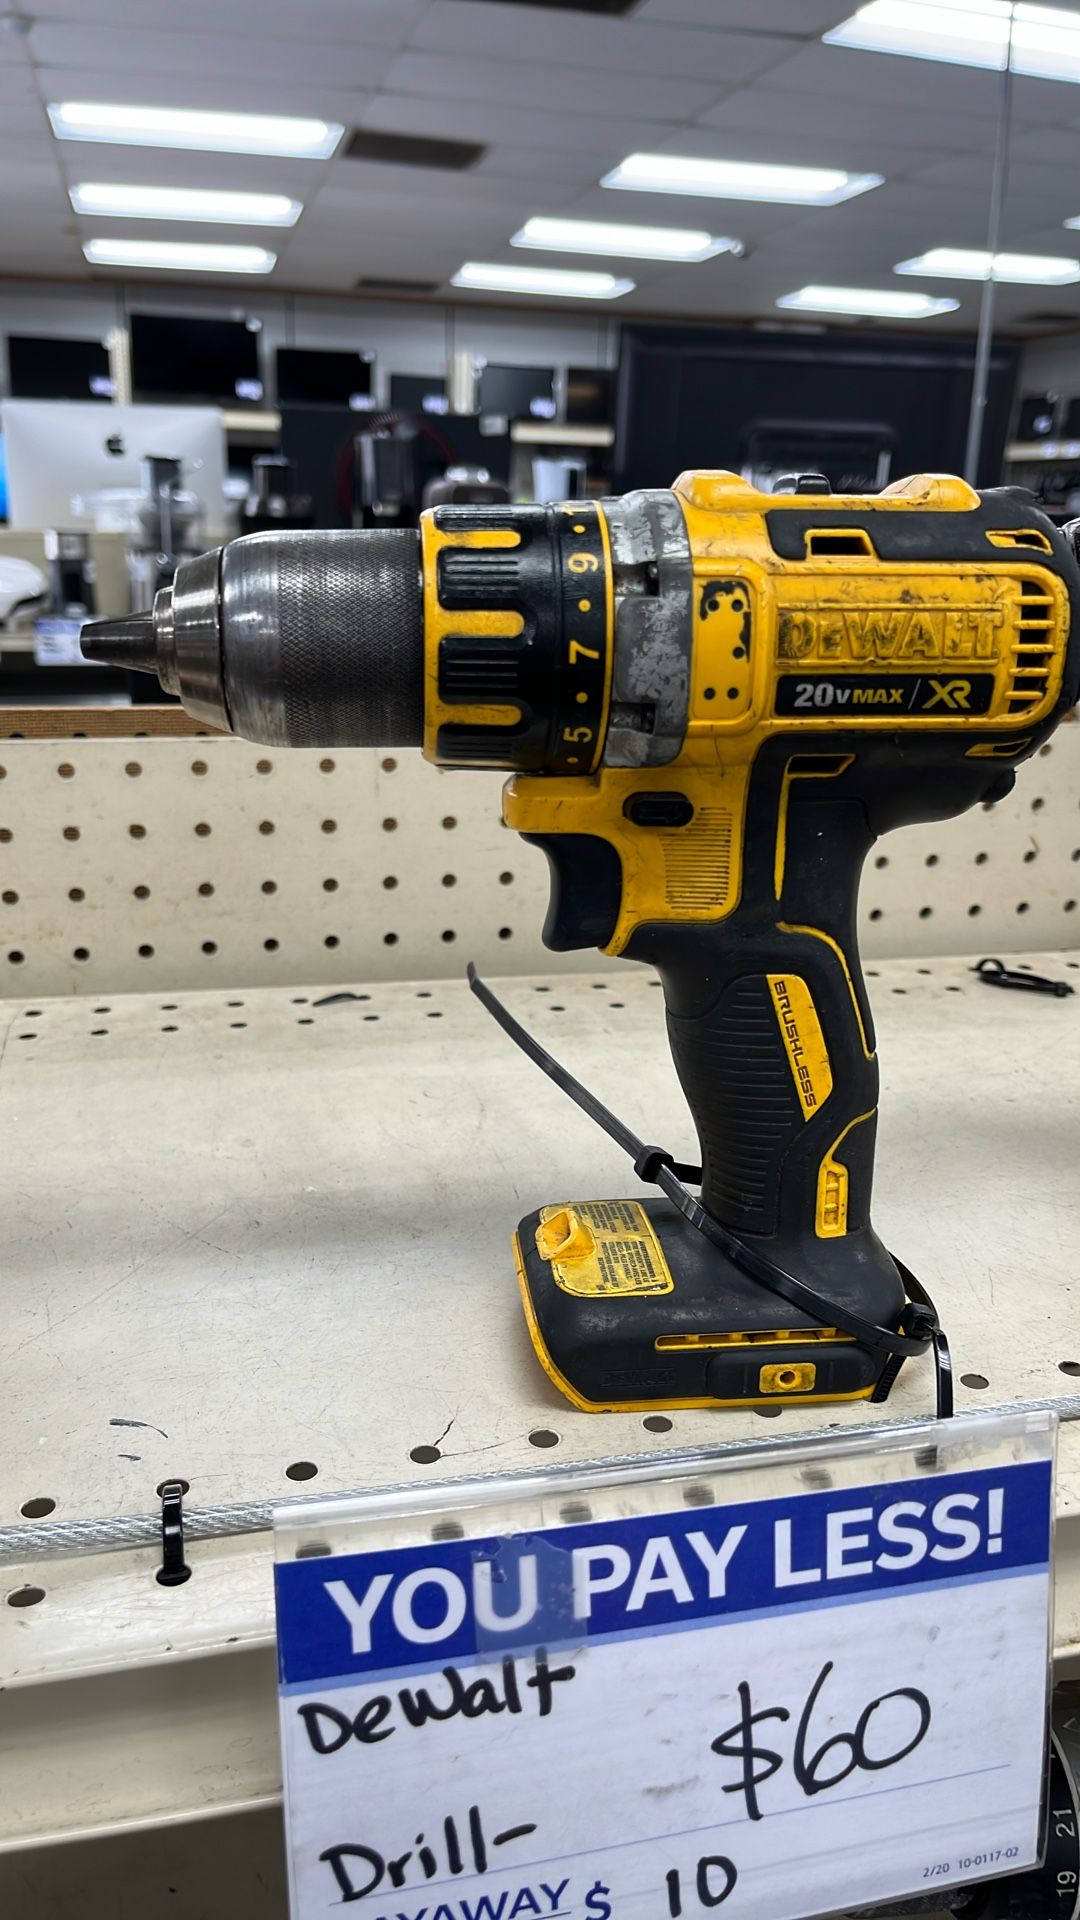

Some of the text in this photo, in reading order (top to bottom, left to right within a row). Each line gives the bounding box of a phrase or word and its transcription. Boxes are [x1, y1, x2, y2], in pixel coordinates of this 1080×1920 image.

[567, 552, 599, 573] 9
[568, 640, 599, 664] 7
[852, 688, 904, 704] MAX
[922, 680, 971, 709] XR
[563, 726, 592, 743] 5
[774, 980, 817, 1108] BRUSHLESS
[323, 1488, 1004, 1655] YOU PAY LESS!
[298, 1647, 575, 1754] DeWalt
[710, 1660, 931, 1820] $60
[1053, 1808, 1076, 1838] 21
[922, 1847, 1019, 1878] 2/20 10-0117-02
[585, 1881, 612, 1920] $
[666, 1856, 737, 1918] 10
[1056, 1870, 1077, 1897] 19
